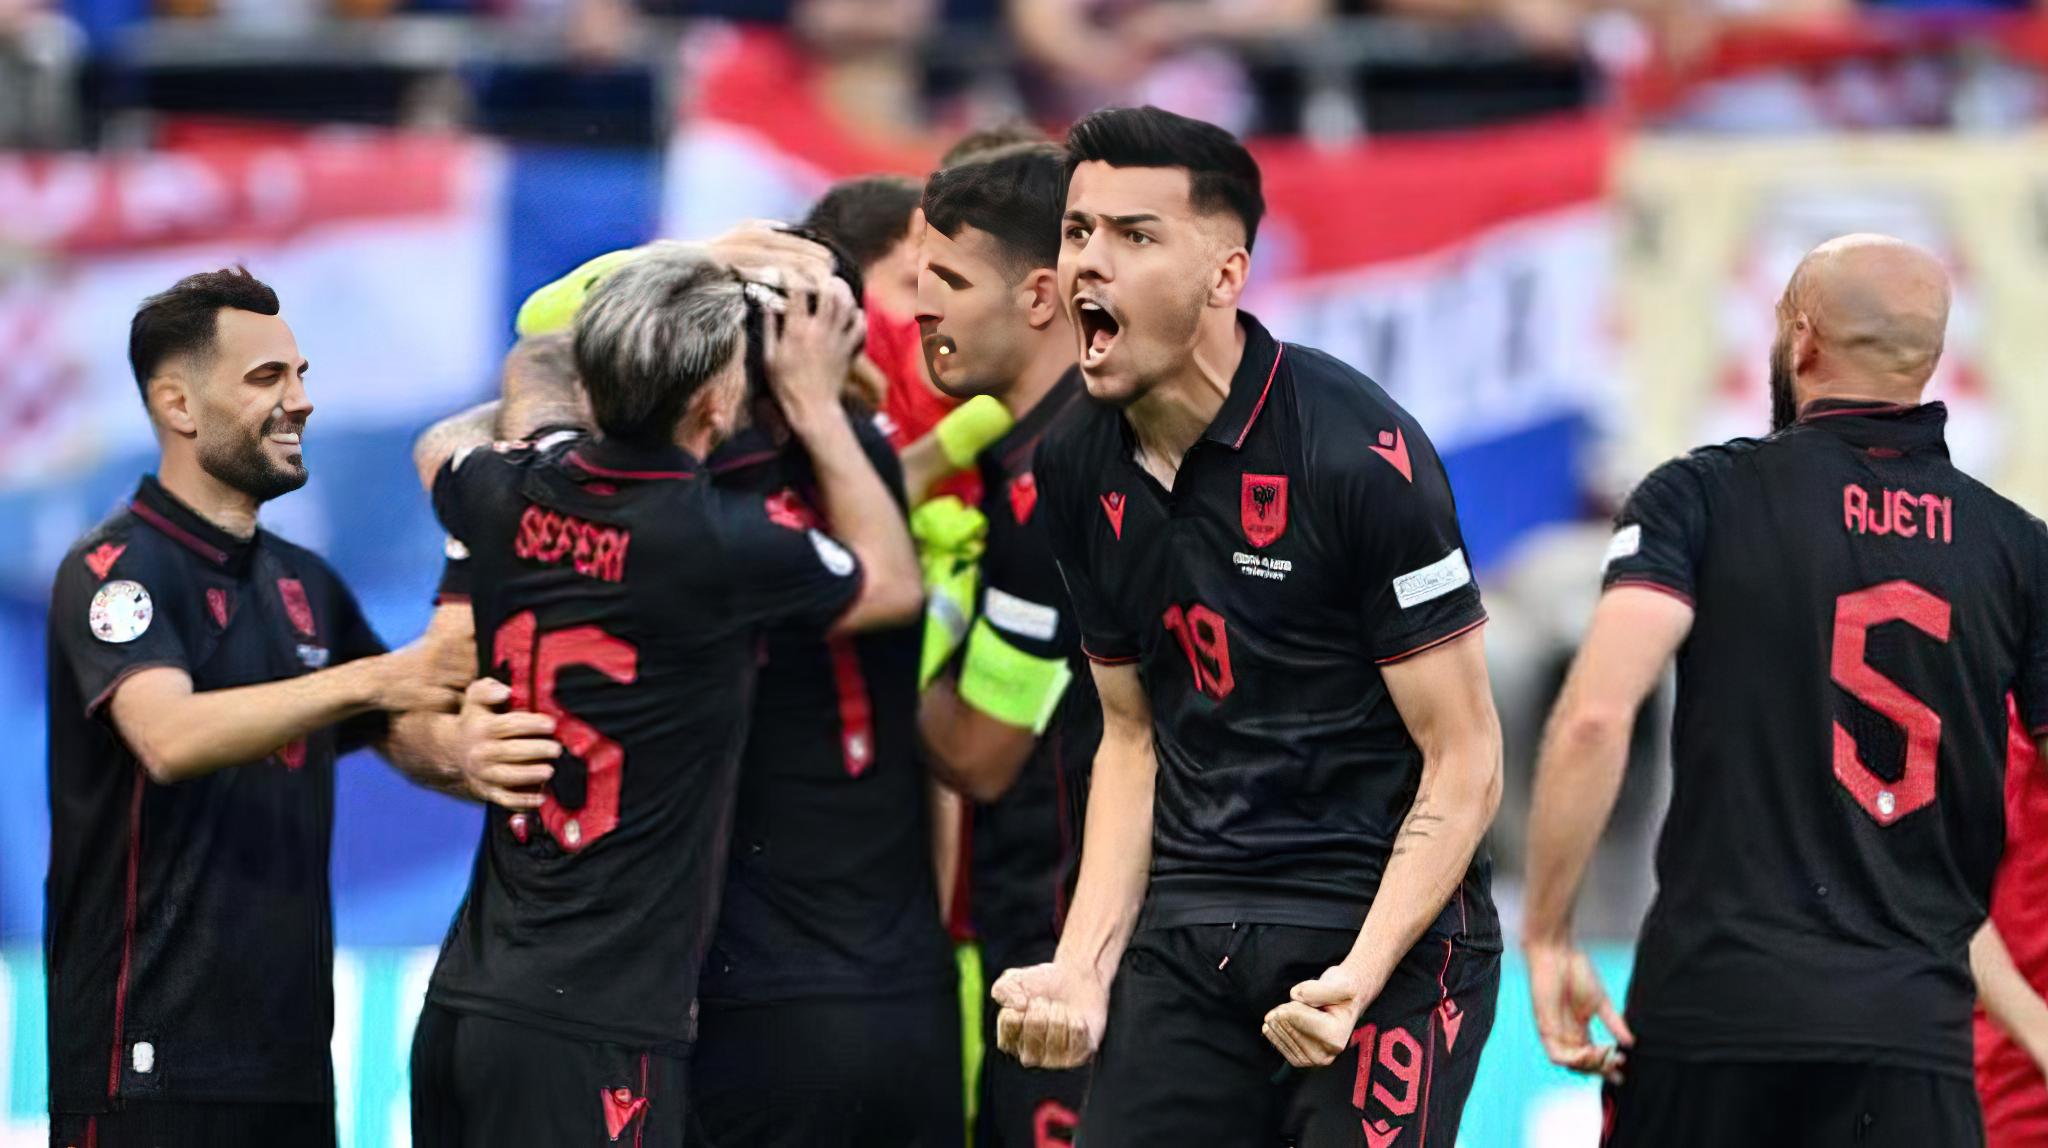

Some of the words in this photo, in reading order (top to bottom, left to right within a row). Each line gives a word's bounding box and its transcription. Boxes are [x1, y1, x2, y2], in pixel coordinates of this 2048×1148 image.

[1843, 484, 1952, 544] AJETI
[1163, 604, 1234, 701] 19
[1830, 579, 1951, 827] 5
[1349, 1023, 1423, 1116] 19
